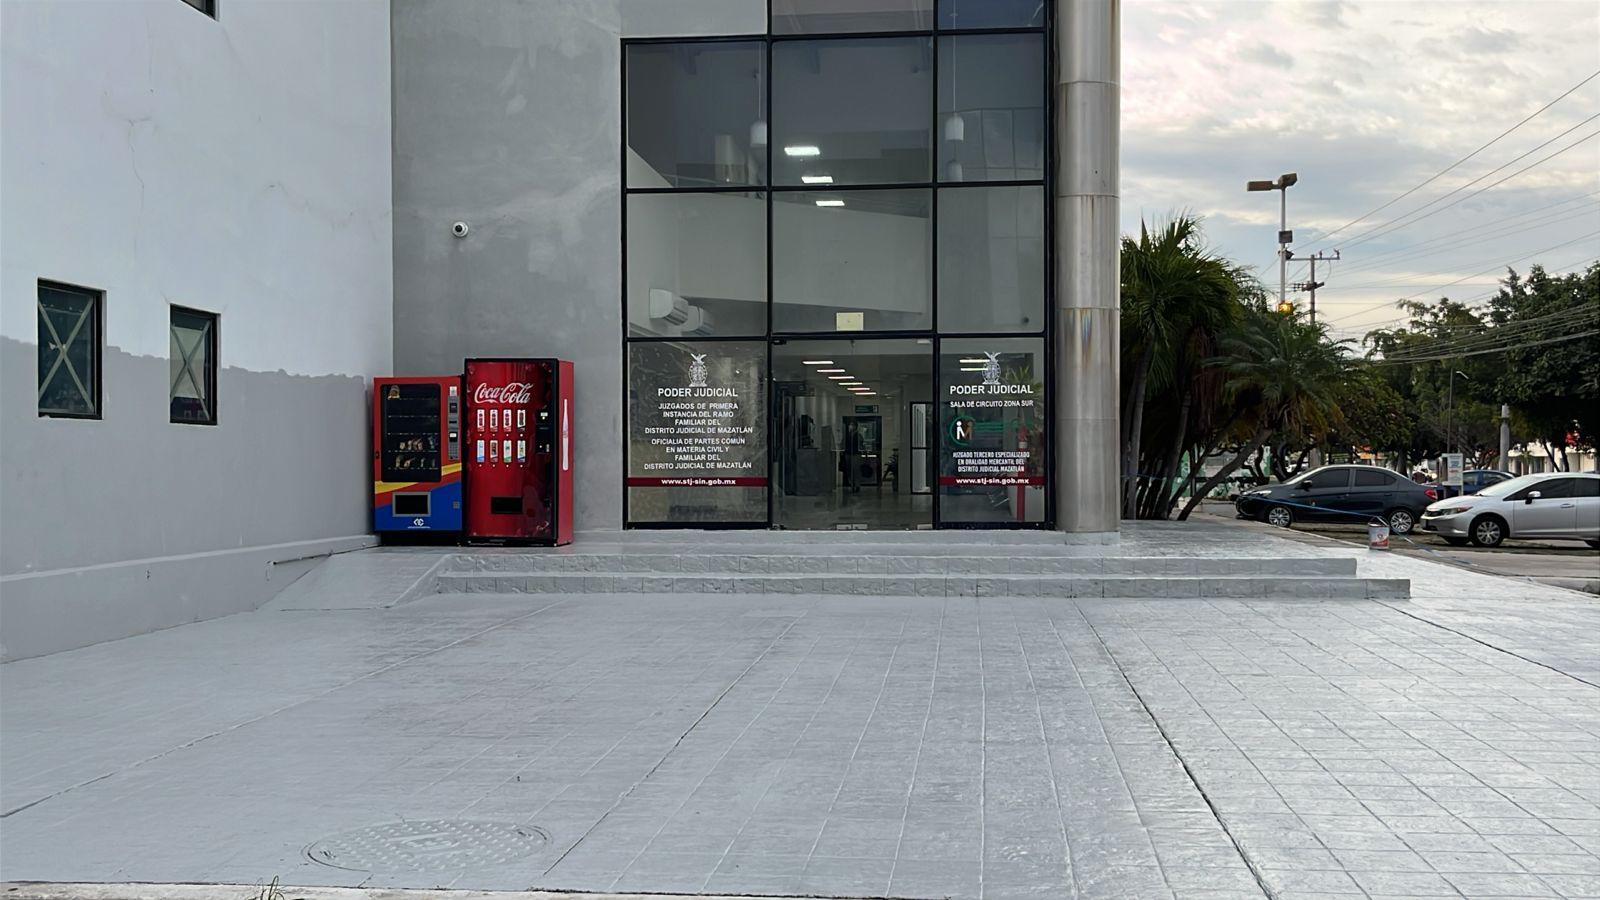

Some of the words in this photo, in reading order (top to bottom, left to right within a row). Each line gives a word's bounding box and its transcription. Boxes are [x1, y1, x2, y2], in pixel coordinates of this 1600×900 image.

[474, 382, 533, 404] Coca-Cola
[658, 388, 692, 397] PODER
[694, 388, 738, 397] JUDICIAL
[950, 385, 985, 394] PODER
[988, 385, 1034, 394] JUDICIAL
